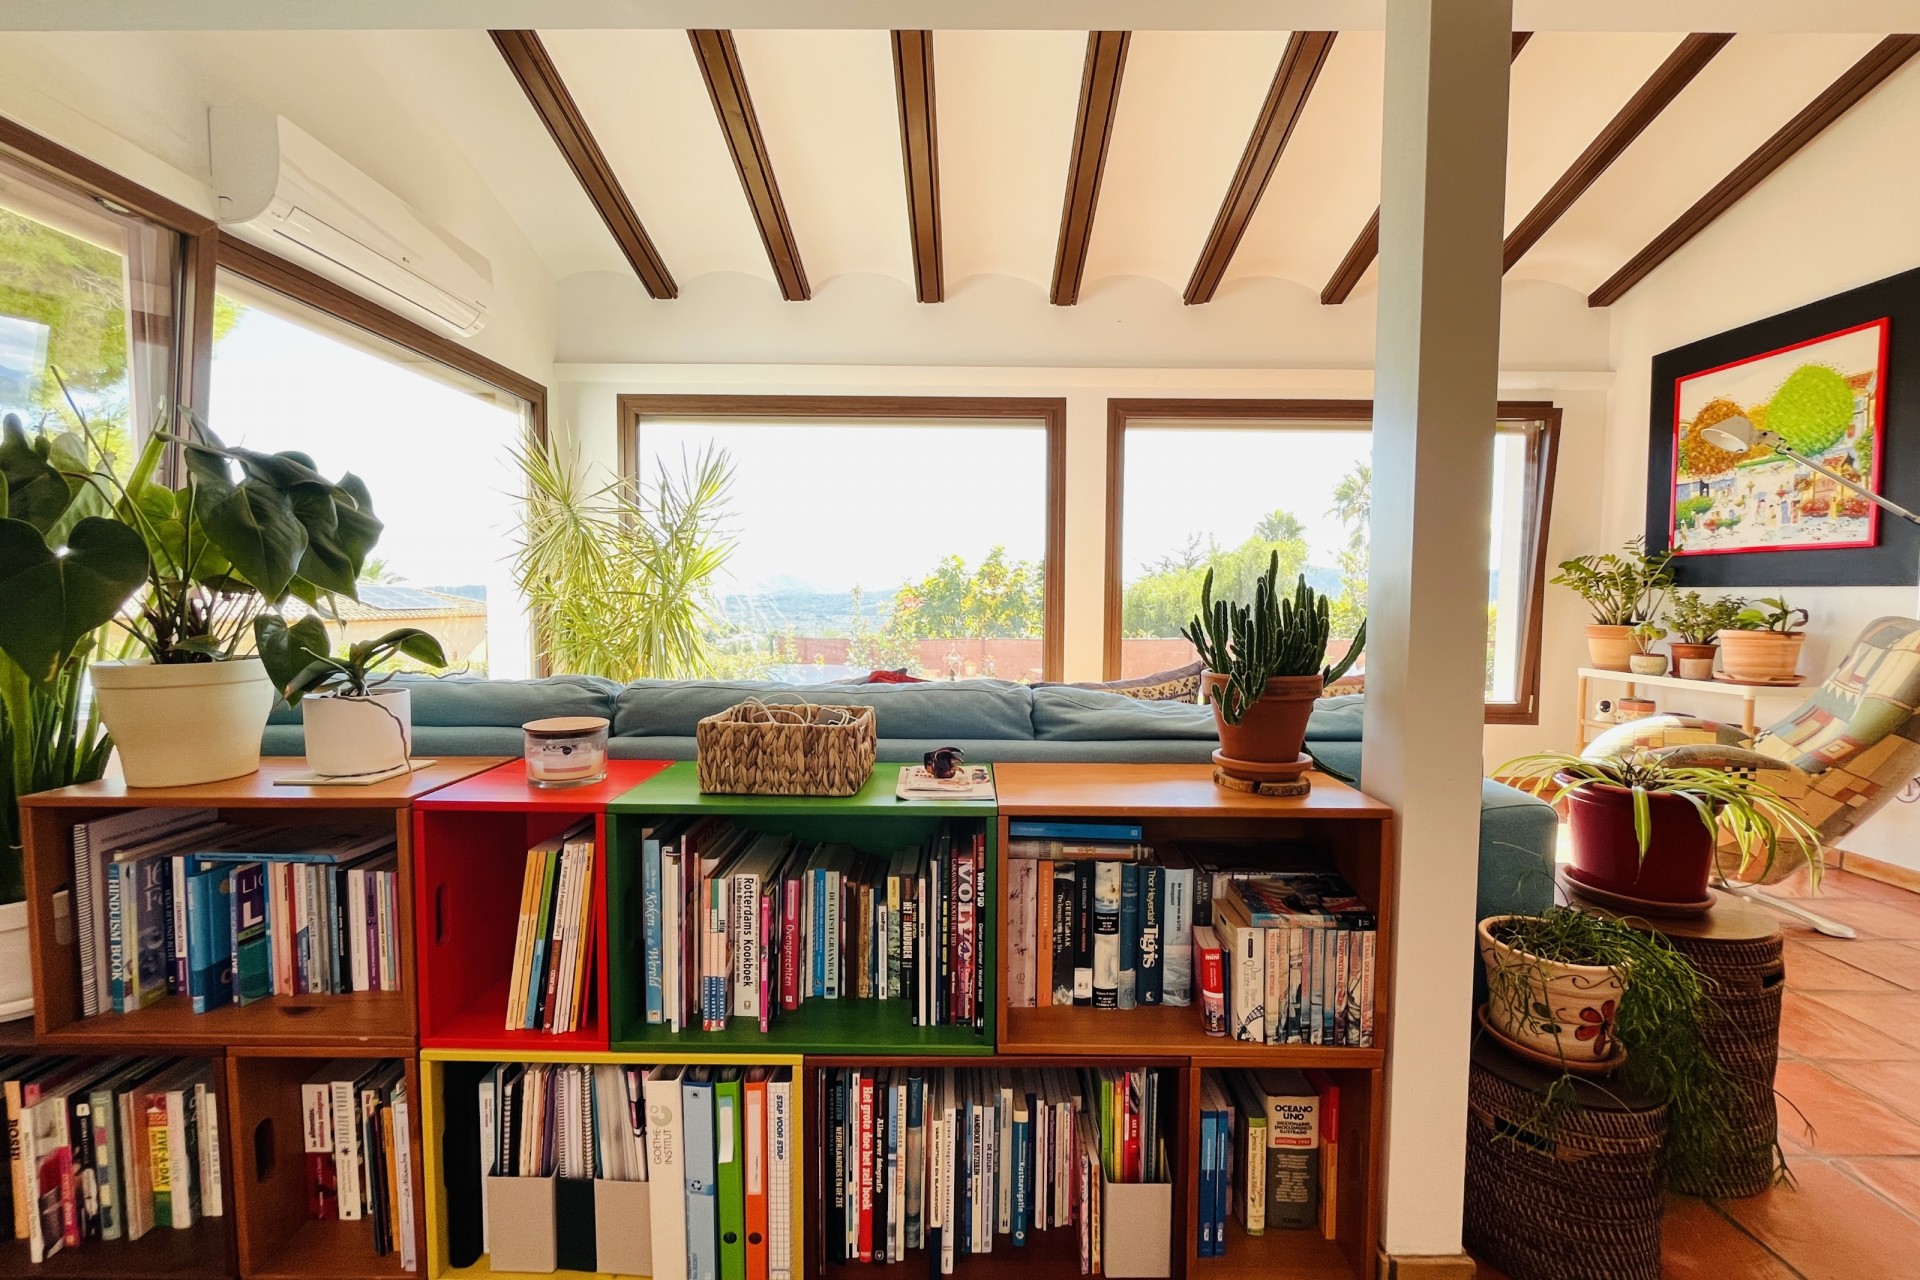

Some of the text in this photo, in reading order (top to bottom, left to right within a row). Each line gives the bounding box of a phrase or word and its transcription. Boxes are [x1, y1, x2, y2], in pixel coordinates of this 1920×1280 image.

[736, 877, 744, 894] Linda
[950, 858, 958, 901] CARAVANNEN
[976, 871, 985, 908] Volvo P120
[1081, 877, 1089, 889] CLIVE
[1196, 877, 1204, 905] LAWSON
[556, 918, 564, 938] Lengua
[560, 866, 569, 891] Literatura
[734, 894, 743, 930] Roodenburg
[902, 901, 913, 914] HET
[950, 901, 958, 921] DOOR
[957, 857, 973, 960] VOLVO
[1056, 894, 1064, 903] De
[1056, 902, 1064, 922] levens
[1081, 889, 1089, 910] CUSSLER
[109, 879, 124, 981] HINDUISM BOOK
[175, 900, 184, 953] COMMUNICATION
[309, 916, 317, 938] ANGER
[743, 877, 755, 988] Rotterdams Kookboek
[879, 911, 887, 932] GoodFood
[951, 922, 957, 931] DE
[1064, 900, 1073, 948] GEERT MAK
[1139, 869, 1159, 969] Thor Heyerdahl Tigris
[644, 891, 662, 988] Koken in de Wereld
[827, 891, 837, 984] DE LAATSTE GRAANRACE
[902, 921, 913, 960] HANDBOEK
[1056, 933, 1064, 944] Jan
[1364, 944, 1372, 960] TAAL
[783, 924, 796, 988] Ovengerechten
[335, 1086, 347, 1112] HERBAL
[1274, 1104, 1313, 1113] OCEANO
[315, 1090, 326, 1149] medicina milagrosa
[337, 1115, 351, 1145] DEFENCE
[775, 1094, 785, 1160] STAP VOOR STAP
[876, 1117, 885, 1139] Alles
[973, 1114, 982, 1145] HANDBOEK
[1283, 1113, 1305, 1121] UNO
[8, 1119, 20, 1162] BOSH!
[653, 1126, 663, 1166] GOETHE-
[662, 1130, 673, 1166] INSTITUT
[835, 1085, 844, 1208] MARITIEM NEDERLANDERS EN DE ZEE
[860, 1086, 874, 1210] Het grote doe het zelf boek
[986, 1143, 993, 1152] DE
[158, 1129, 171, 1188] FIVE-A-DAY
[172, 1159, 182, 1180] juice
[934, 1167, 939, 1177] EN
[943, 1113, 953, 1234] Digitale fotografie en beeldbewerking
[973, 1145, 982, 1176] KUSTZEILEN
[1249, 1153, 1259, 1181] Storybook
[875, 1157, 885, 1194] fotografie
[1016, 1161, 1028, 1214] Kustnavigatie
[64, 1201, 74, 1227] detox
